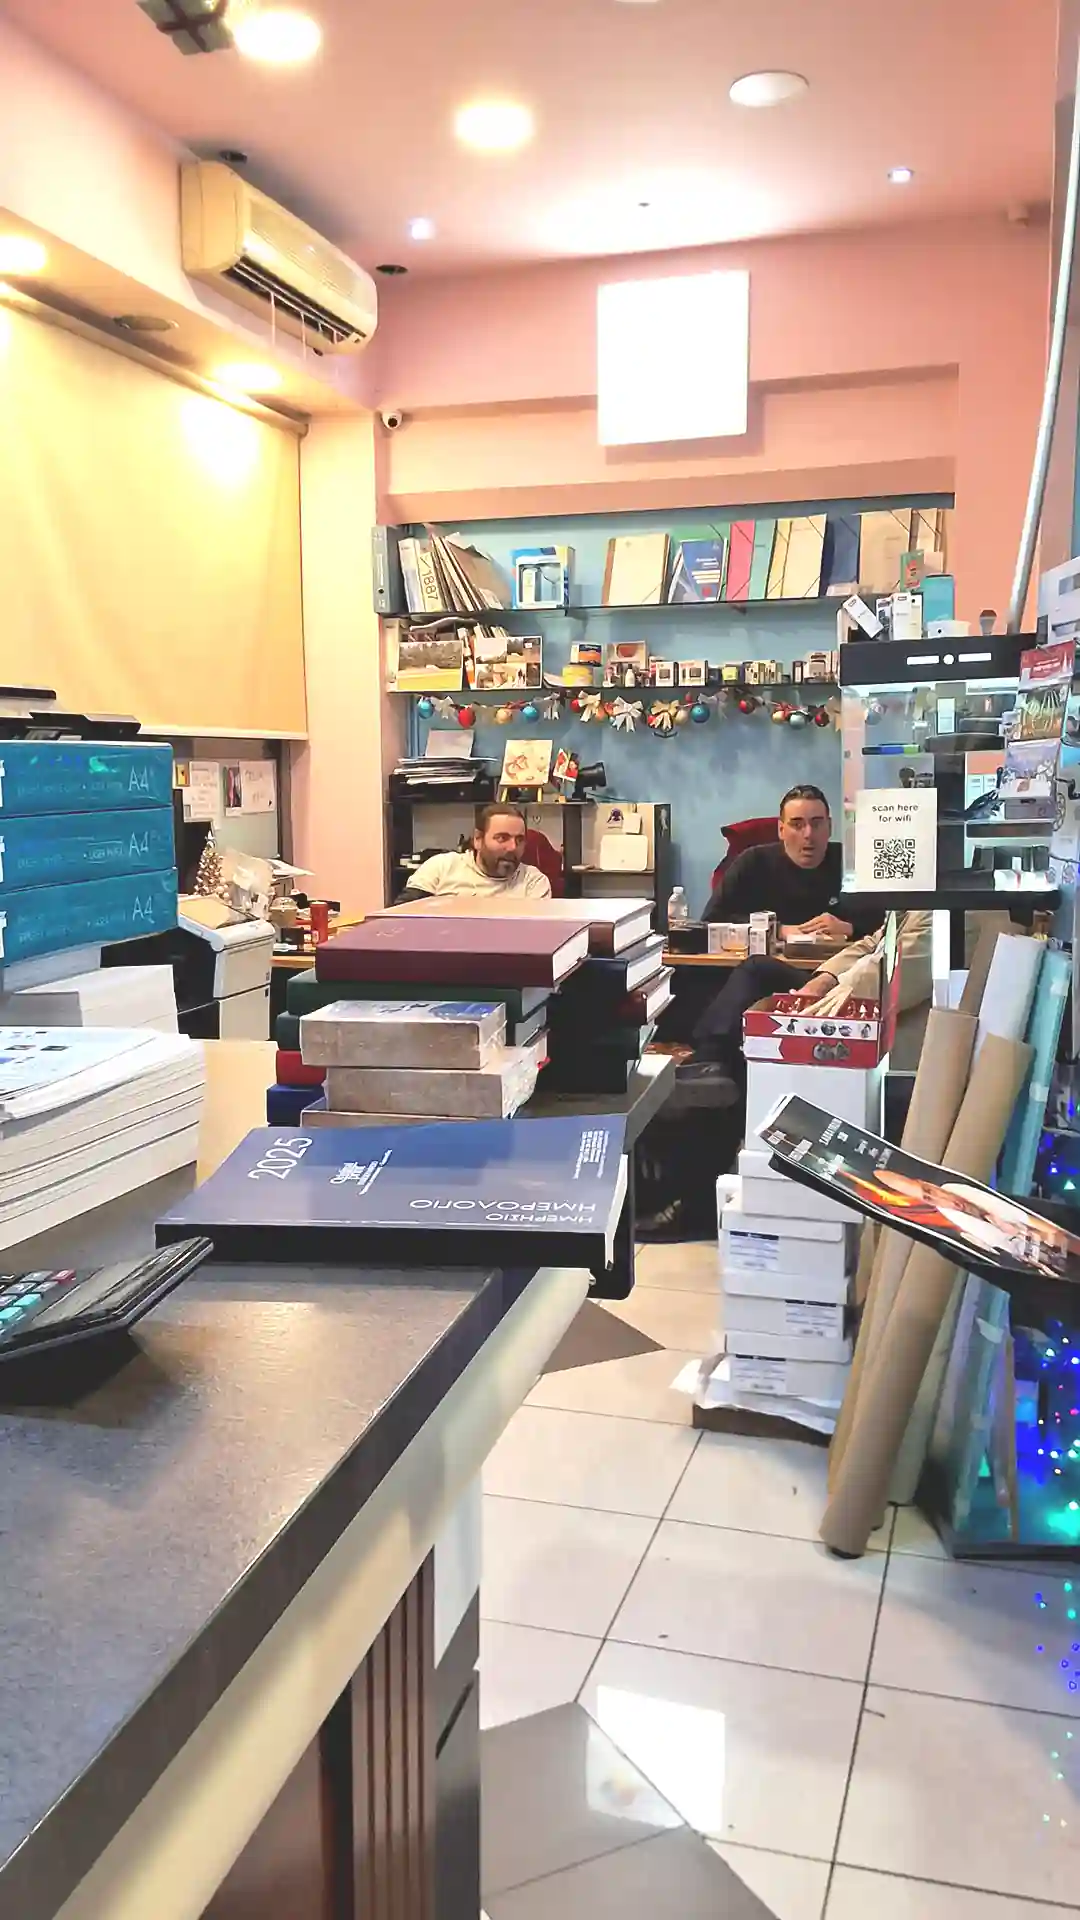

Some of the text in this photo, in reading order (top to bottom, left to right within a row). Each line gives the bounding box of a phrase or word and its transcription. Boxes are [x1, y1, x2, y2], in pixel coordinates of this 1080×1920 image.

[128, 765, 149, 791] A4
[897, 803, 919, 811] here
[879, 814, 911, 822] for wifi
[128, 831, 149, 857] A4
[132, 895, 153, 921] A4
[248, 1137, 313, 1181] 2025
[409, 1198, 596, 1213] ΗΜΕΡΟΛΟΓΙΟ
[486, 1212, 593, 1224] ΗΜΕΡΗΣΙΟ
